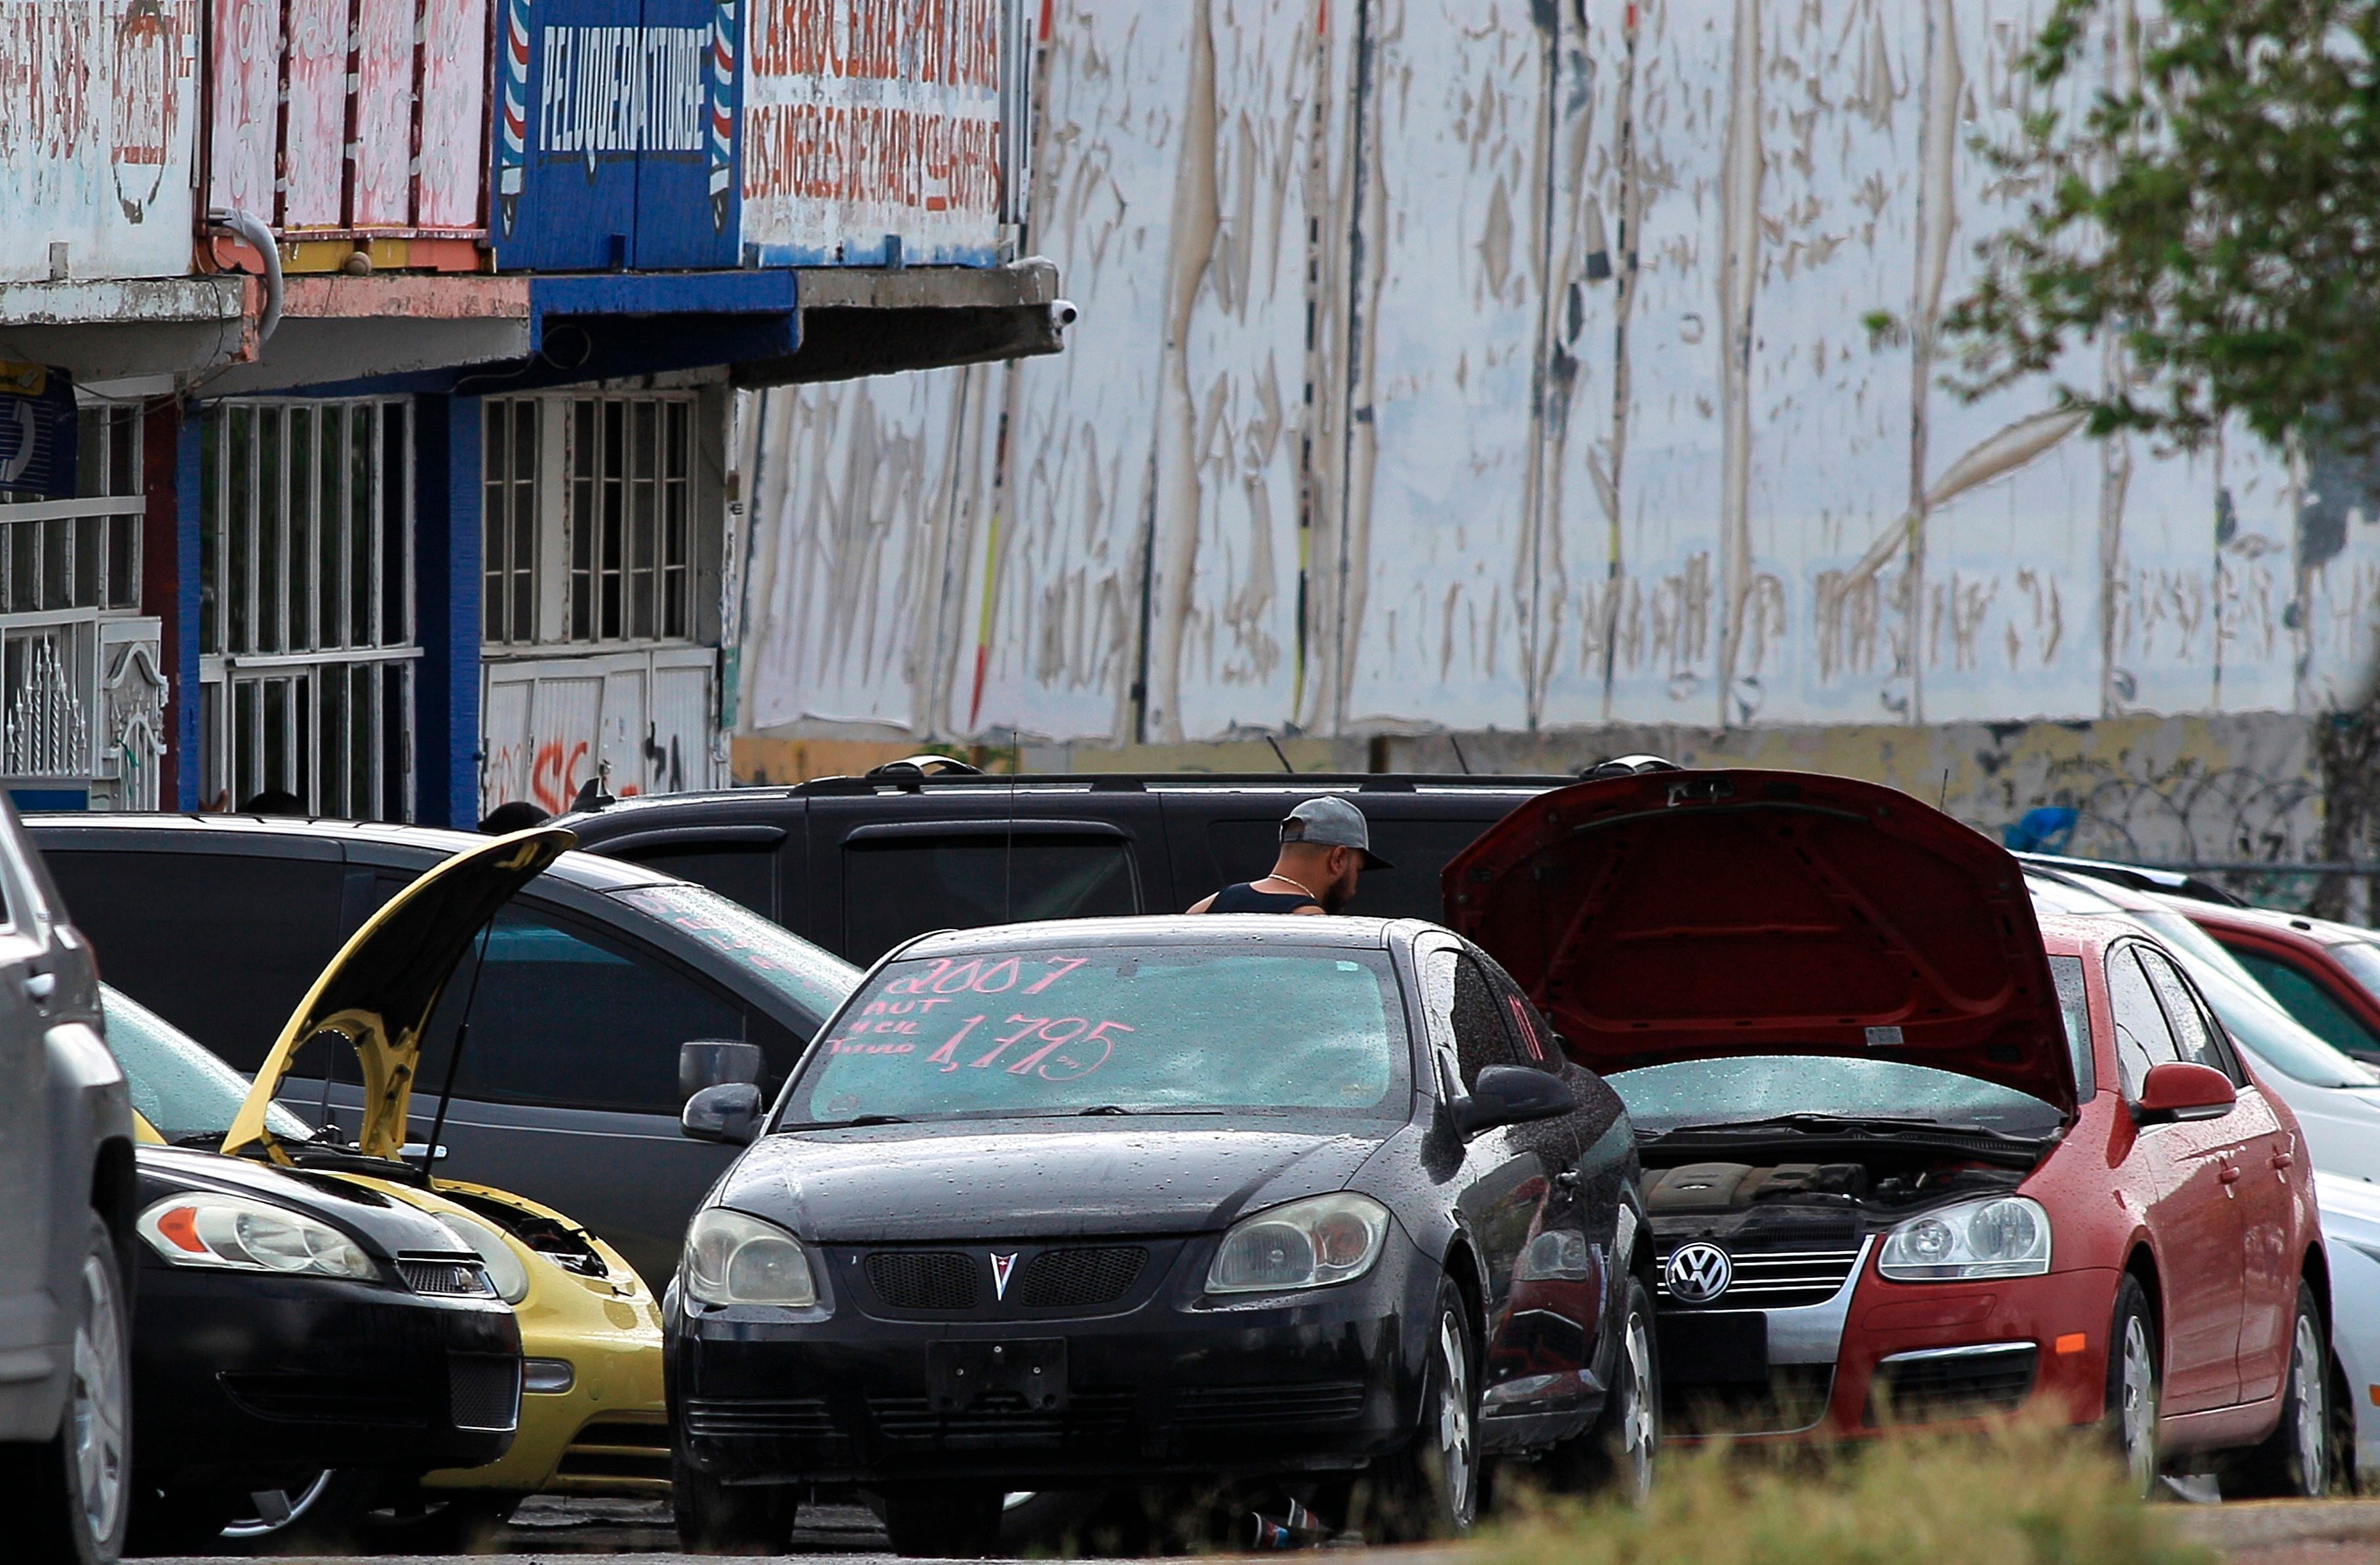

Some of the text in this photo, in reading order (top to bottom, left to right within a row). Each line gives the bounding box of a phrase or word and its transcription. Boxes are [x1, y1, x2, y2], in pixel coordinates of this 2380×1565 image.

[539, 26, 648, 172] PELUQUERIA
[743, 106, 769, 200] LOS
[771, 104, 844, 201] ANGELES
[861, 999, 952, 1017] AUT
[887, 957, 1090, 994] 2007
[925, 1014, 1135, 1081] 1,795
